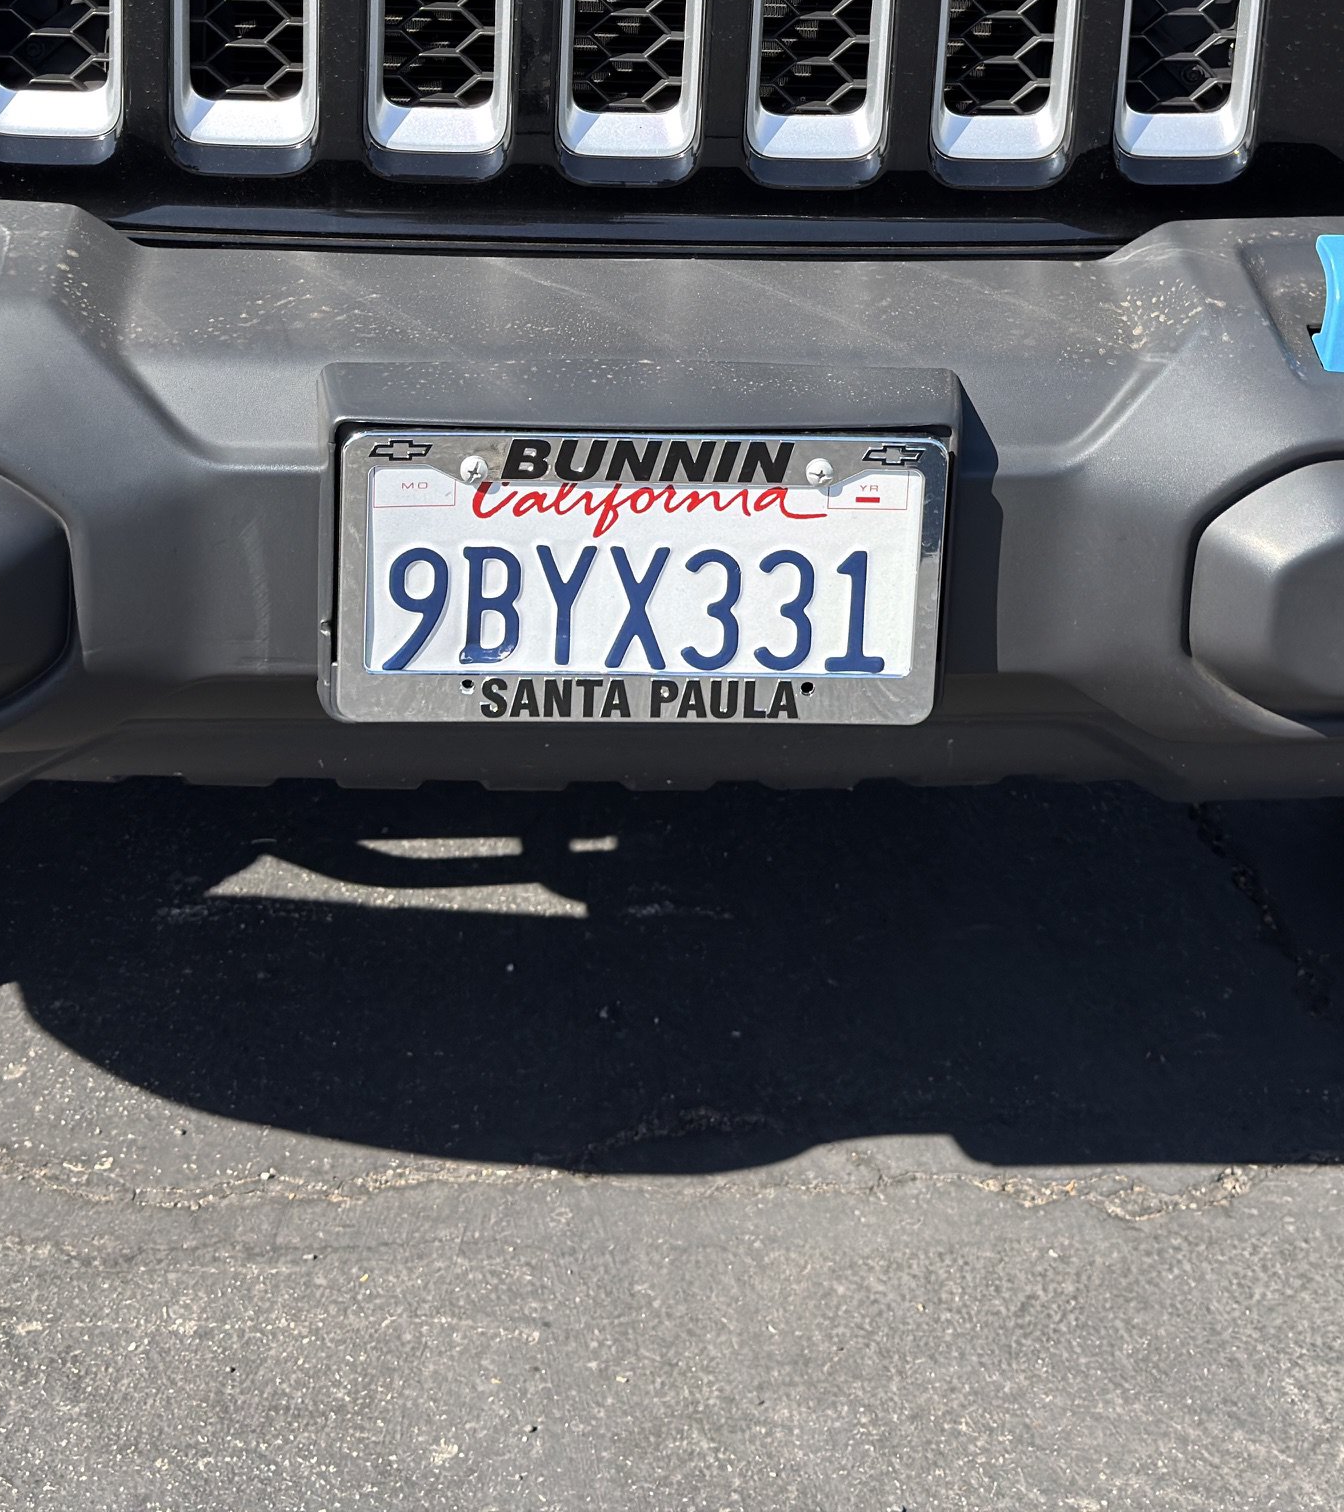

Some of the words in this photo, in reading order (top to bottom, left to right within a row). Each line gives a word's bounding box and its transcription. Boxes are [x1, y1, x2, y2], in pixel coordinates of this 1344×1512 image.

[501, 437, 795, 485] BUNNIN
[401, 481, 428, 489] MO
[859, 484, 879, 492] YR
[471, 480, 827, 537] California
[382, 545, 885, 671] 9BYX331
[480, 678, 632, 719] SANTA
[650, 678, 798, 720] PAULA
